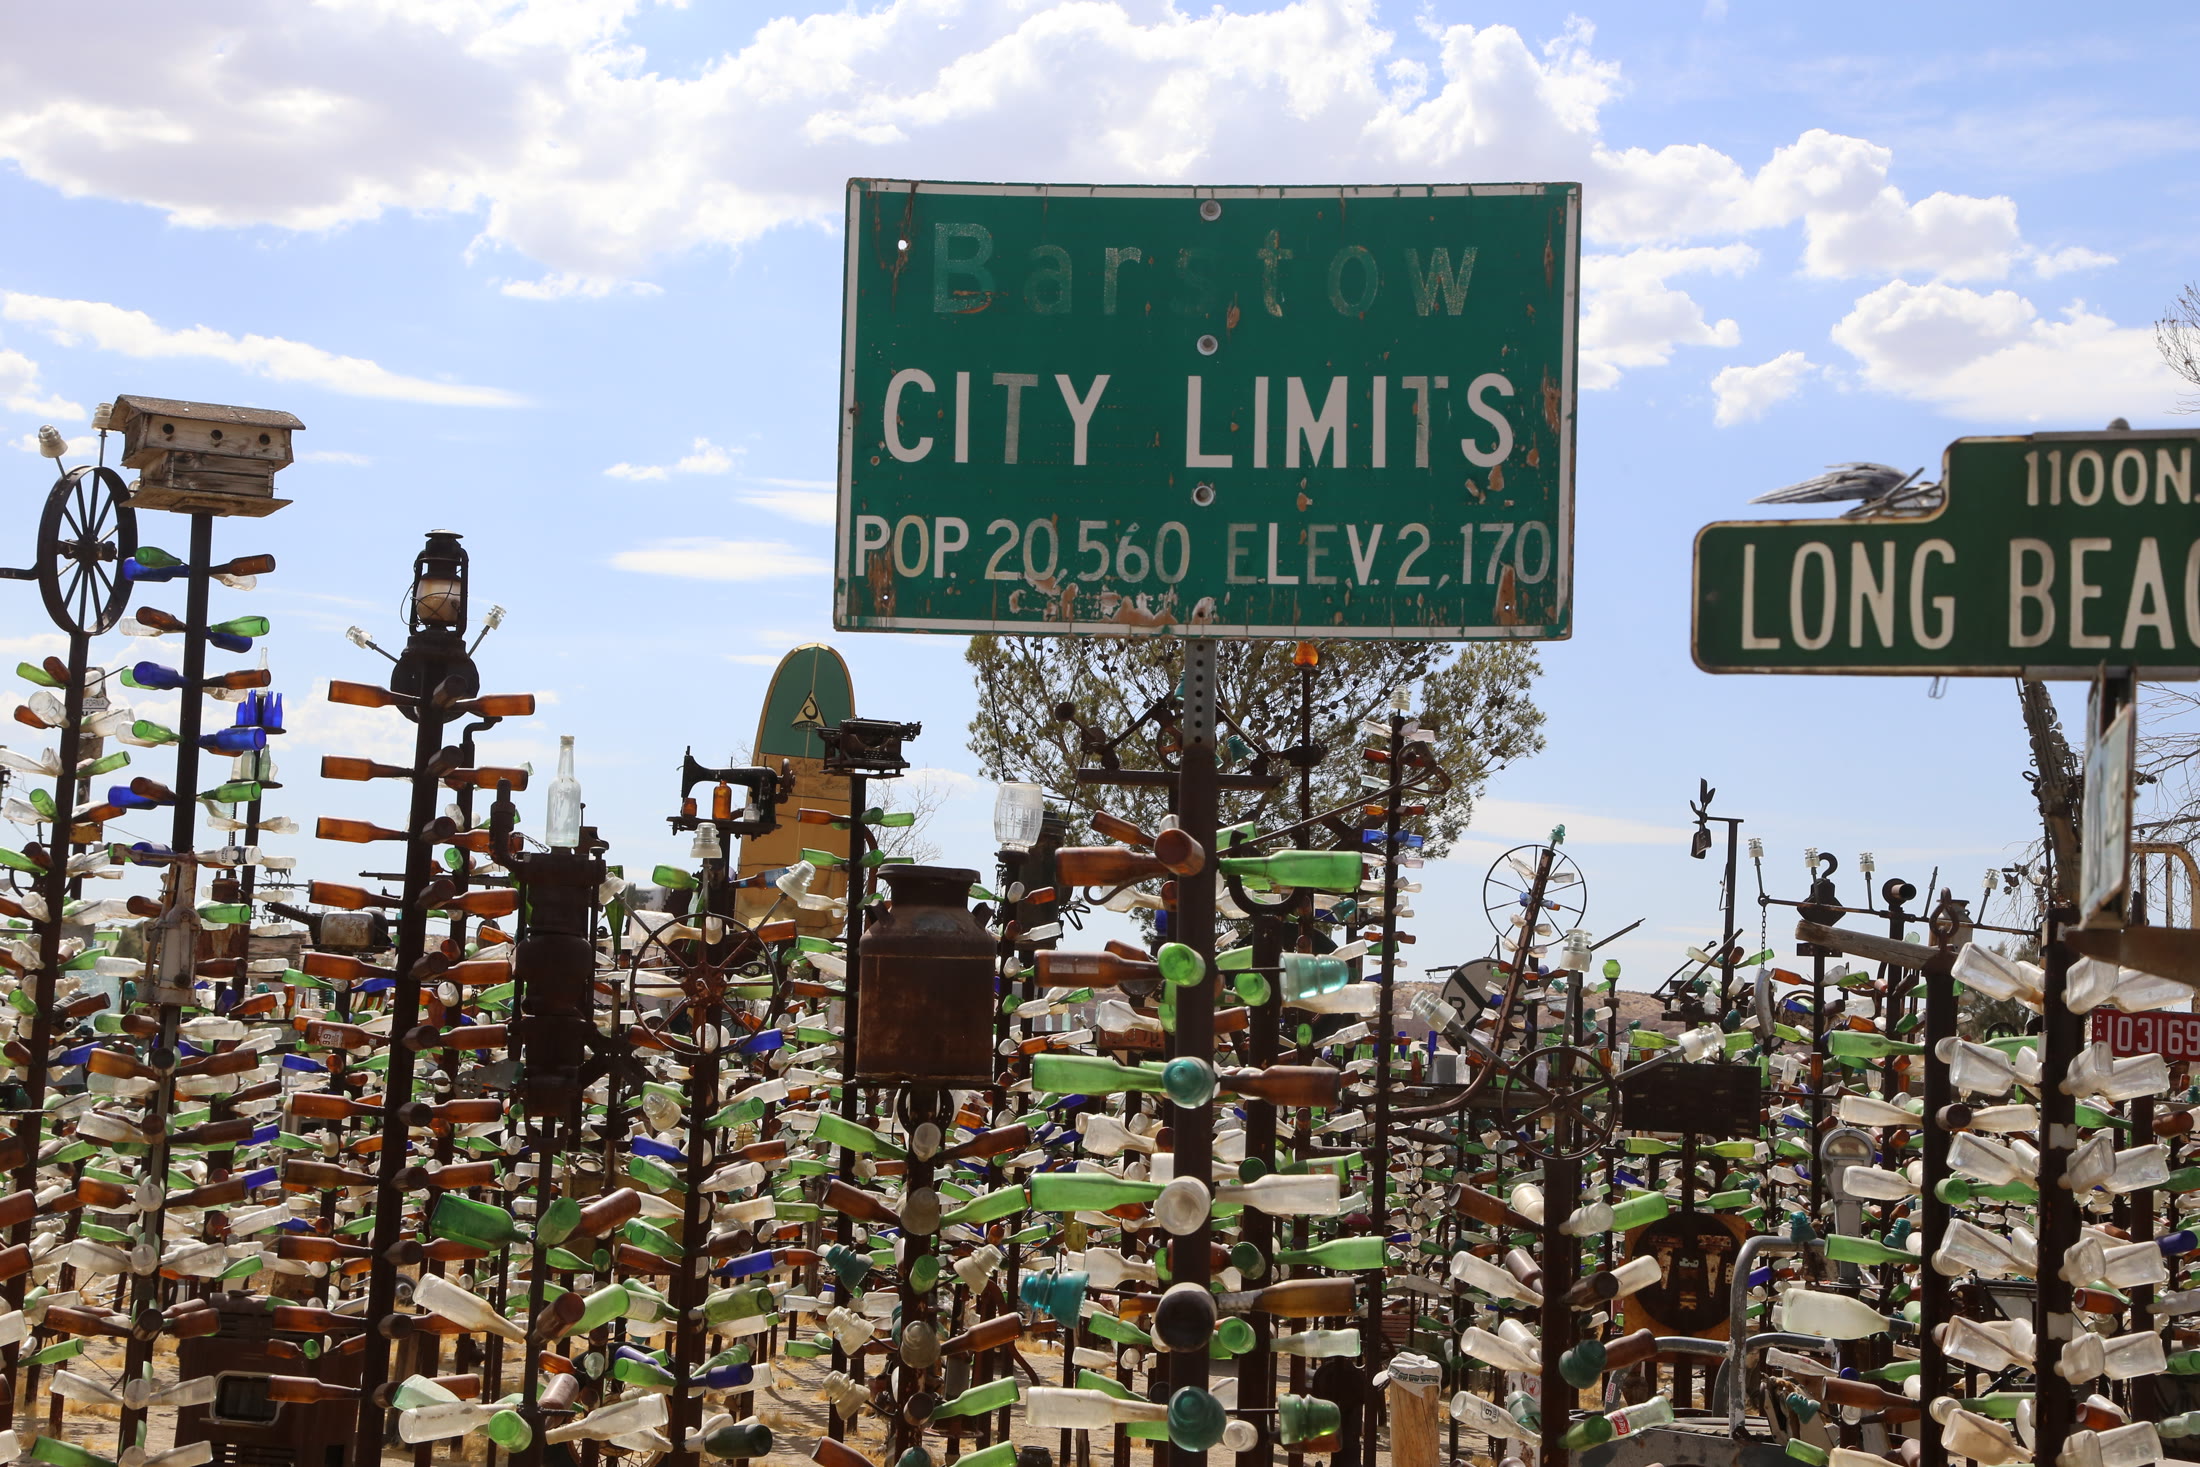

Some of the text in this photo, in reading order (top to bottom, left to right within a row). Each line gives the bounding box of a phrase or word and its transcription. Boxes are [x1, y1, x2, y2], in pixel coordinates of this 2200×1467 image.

[883, 368, 1515, 469] CITY LIMITS
[984, 518, 1191, 588] 20,560
[1395, 520, 1551, 590] 2,170
[1741, 538, 1956, 651] LONG
[2107, 1015, 2200, 1056] 103169
